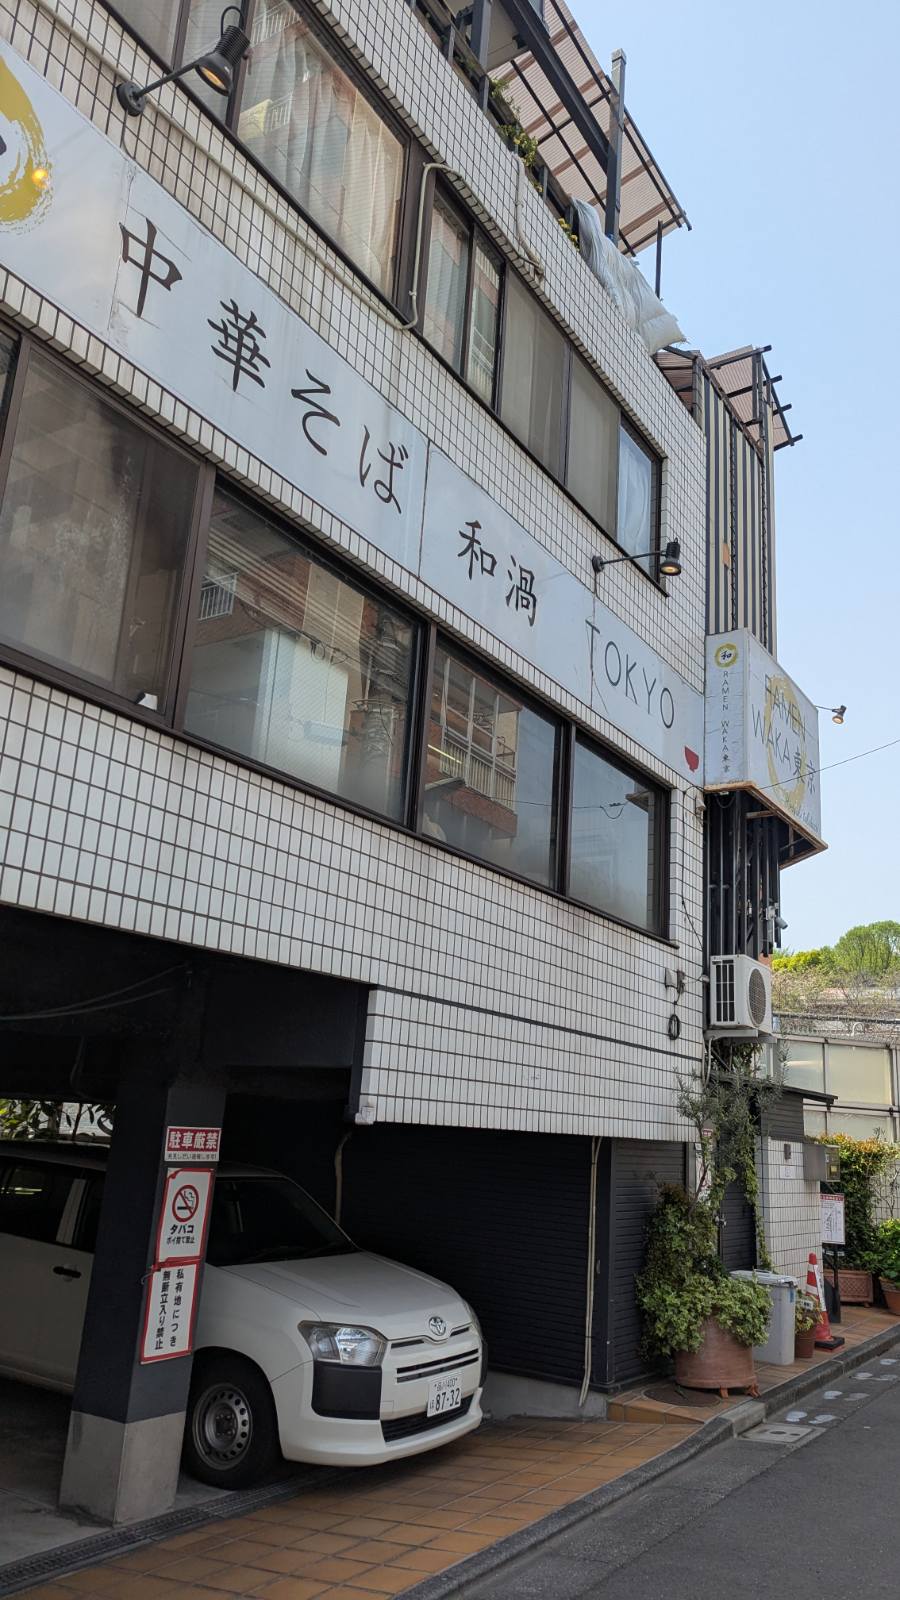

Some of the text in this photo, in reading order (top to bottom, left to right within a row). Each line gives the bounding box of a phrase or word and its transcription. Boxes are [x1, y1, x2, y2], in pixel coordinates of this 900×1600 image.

[119, 217, 675, 729] 中華そば 和渦 TOKYO
[721, 671, 730, 711] RAMEN
[765, 674, 806, 742] RAMEN
[168, 1131, 218, 1150] 駐車厳禁
[170, 1224, 195, 1235] タバコ
[155, 1270, 171, 1350] 無断立入り禁止
[170, 1268, 185, 1347] 私有地につき
